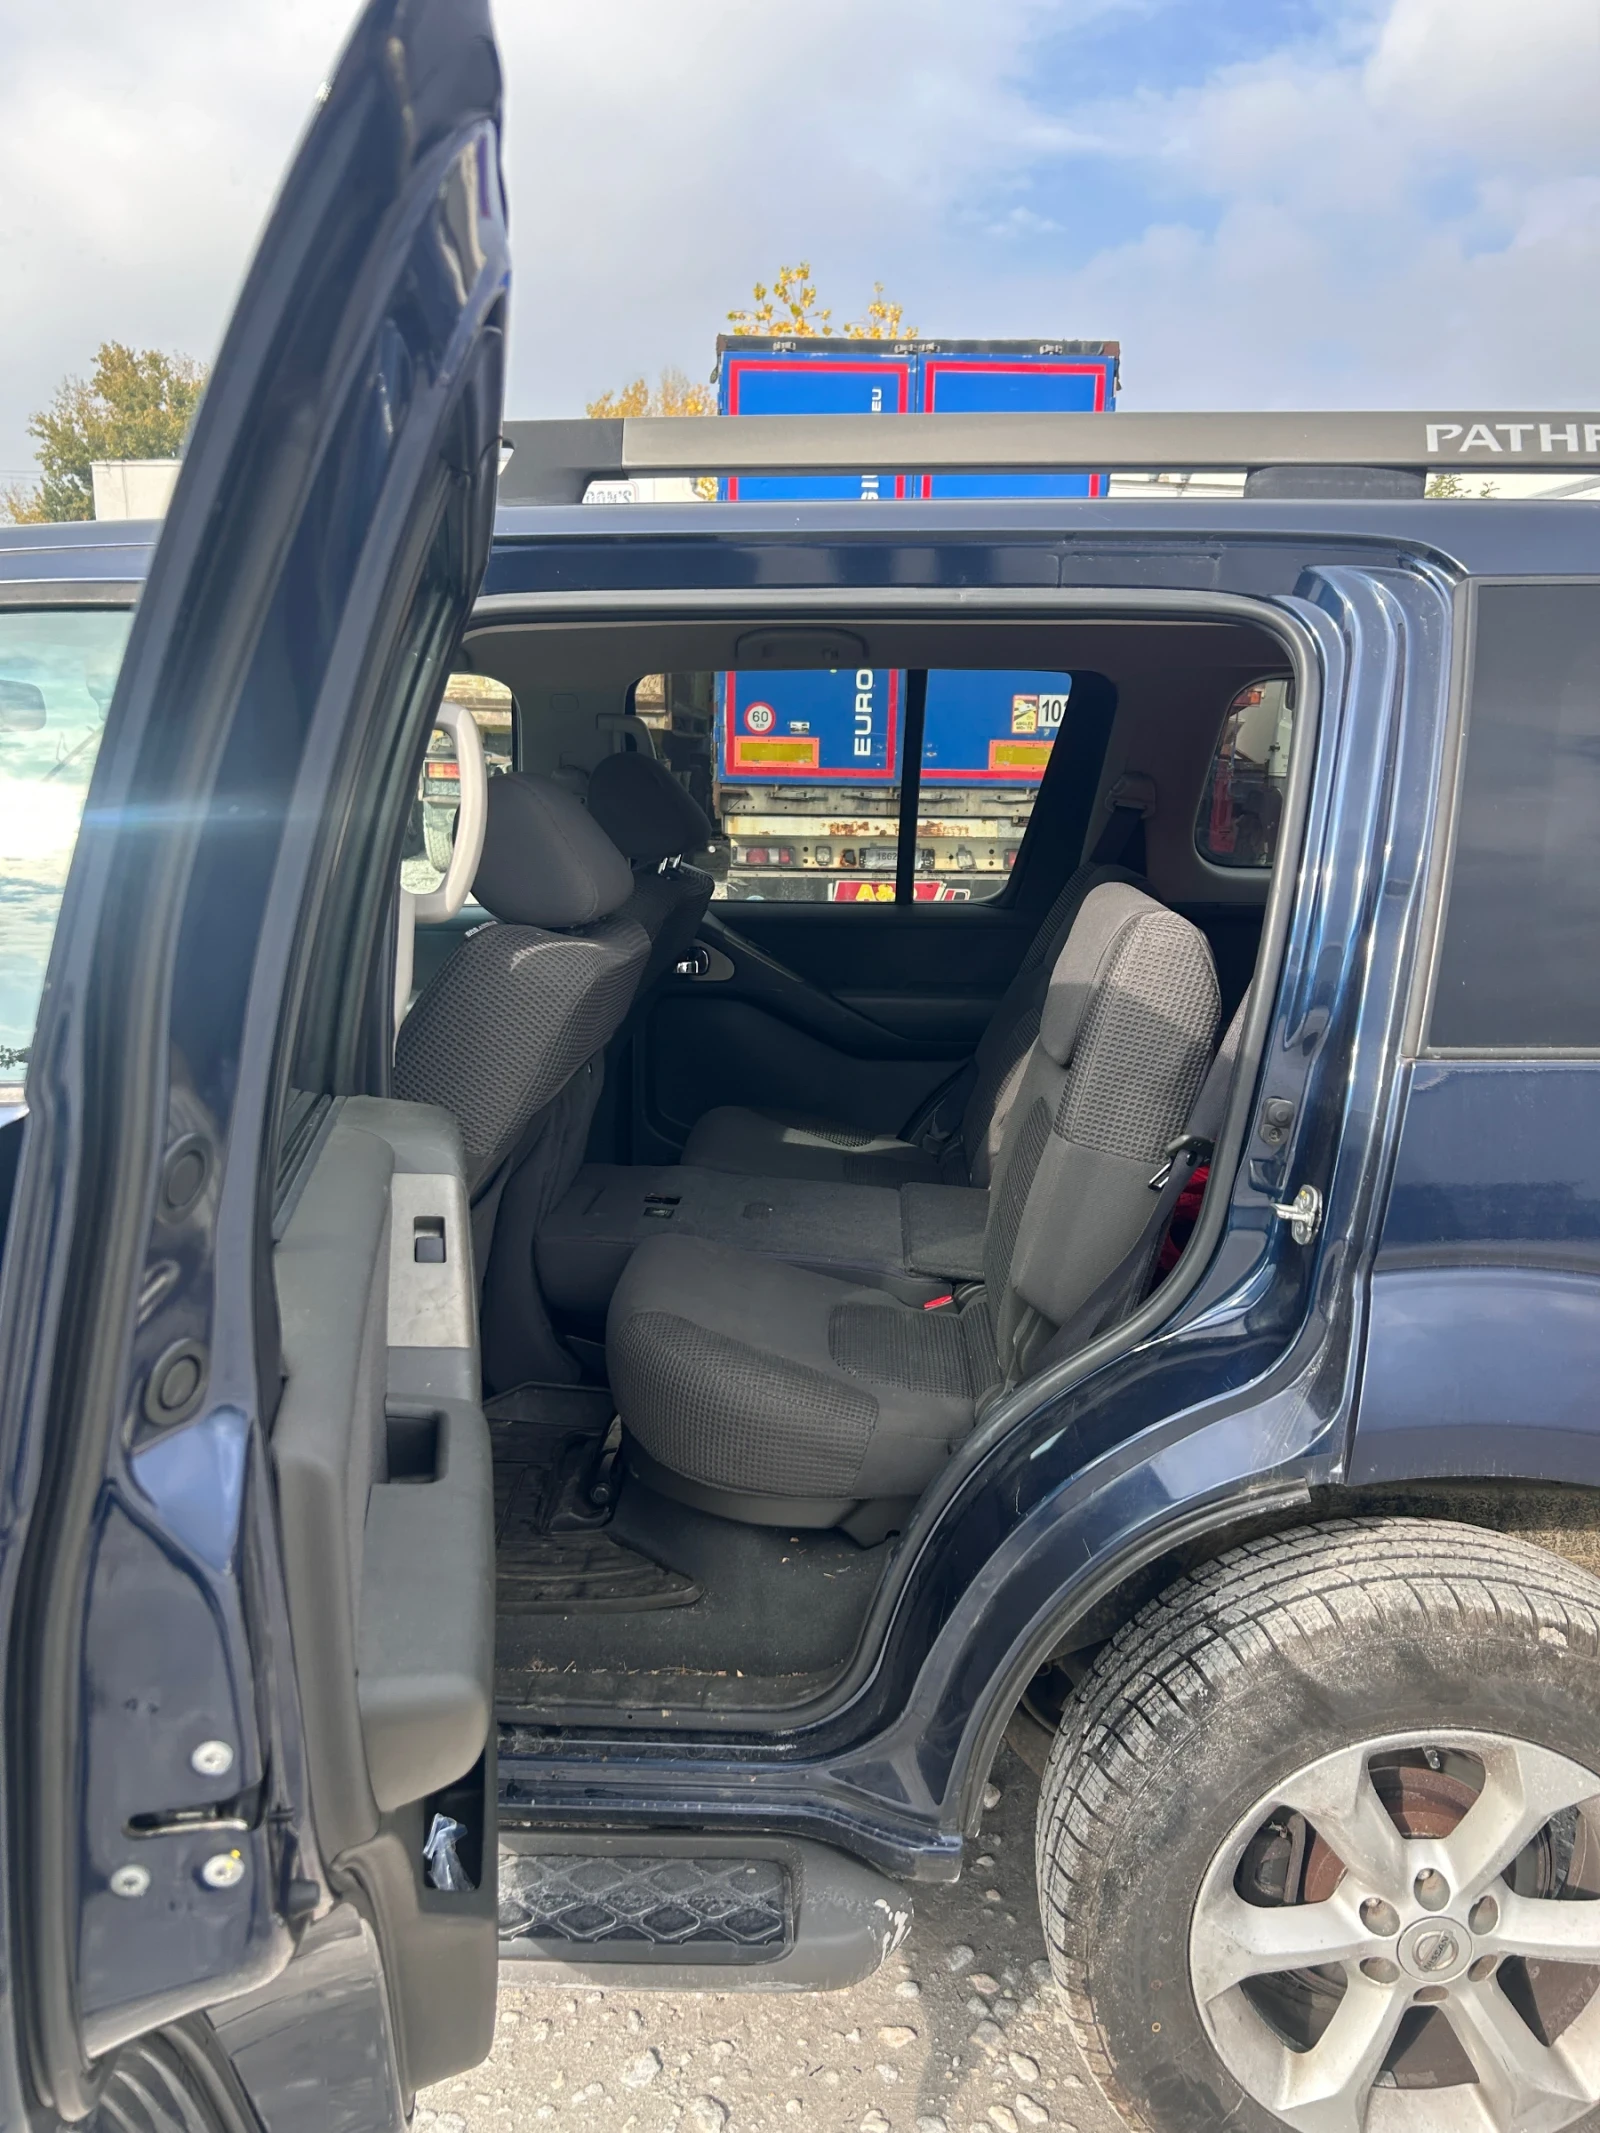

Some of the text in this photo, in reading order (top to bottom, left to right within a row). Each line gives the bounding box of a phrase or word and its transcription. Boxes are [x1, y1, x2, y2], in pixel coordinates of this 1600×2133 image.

[871, 387, 883, 412] EU
[752, 710, 769, 723] 60
[854, 668, 874, 756] EURO
[1041, 699, 1068, 723] 10
[1422, 1935, 1450, 1971] NISSAN
